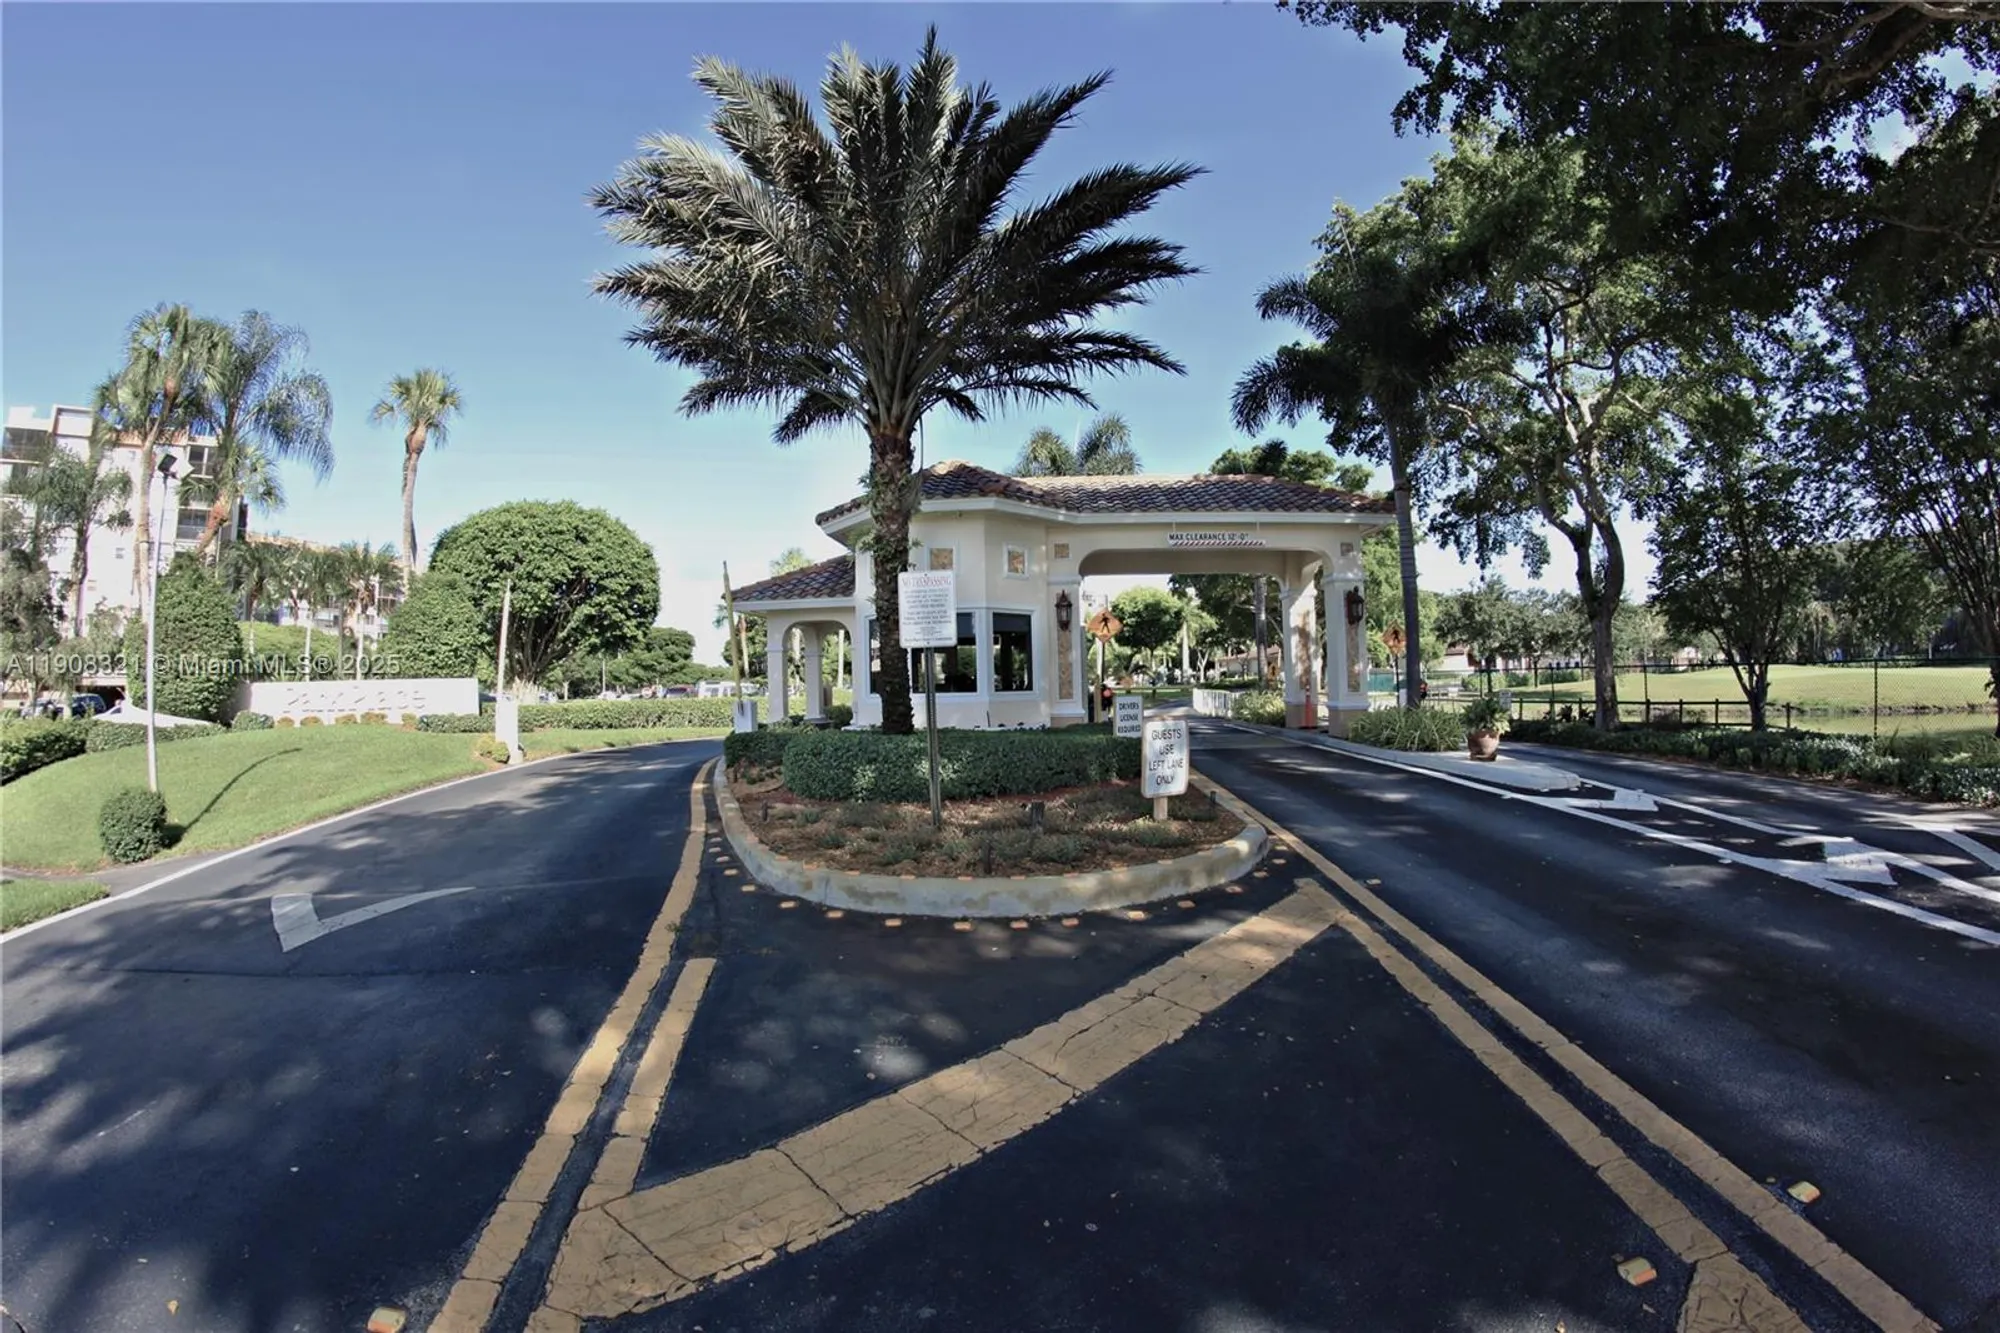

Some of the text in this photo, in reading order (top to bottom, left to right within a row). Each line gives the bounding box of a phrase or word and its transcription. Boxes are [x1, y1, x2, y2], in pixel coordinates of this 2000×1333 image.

[1168, 532, 1183, 541] MAX
[1185, 532, 1226, 541] CLEARANCE
[1151, 728, 1182, 741] GUESTS
[1159, 744, 1175, 756] USE
[1148, 758, 1184, 772] LEFT LANE
[1156, 775, 1174, 786] ONLY
